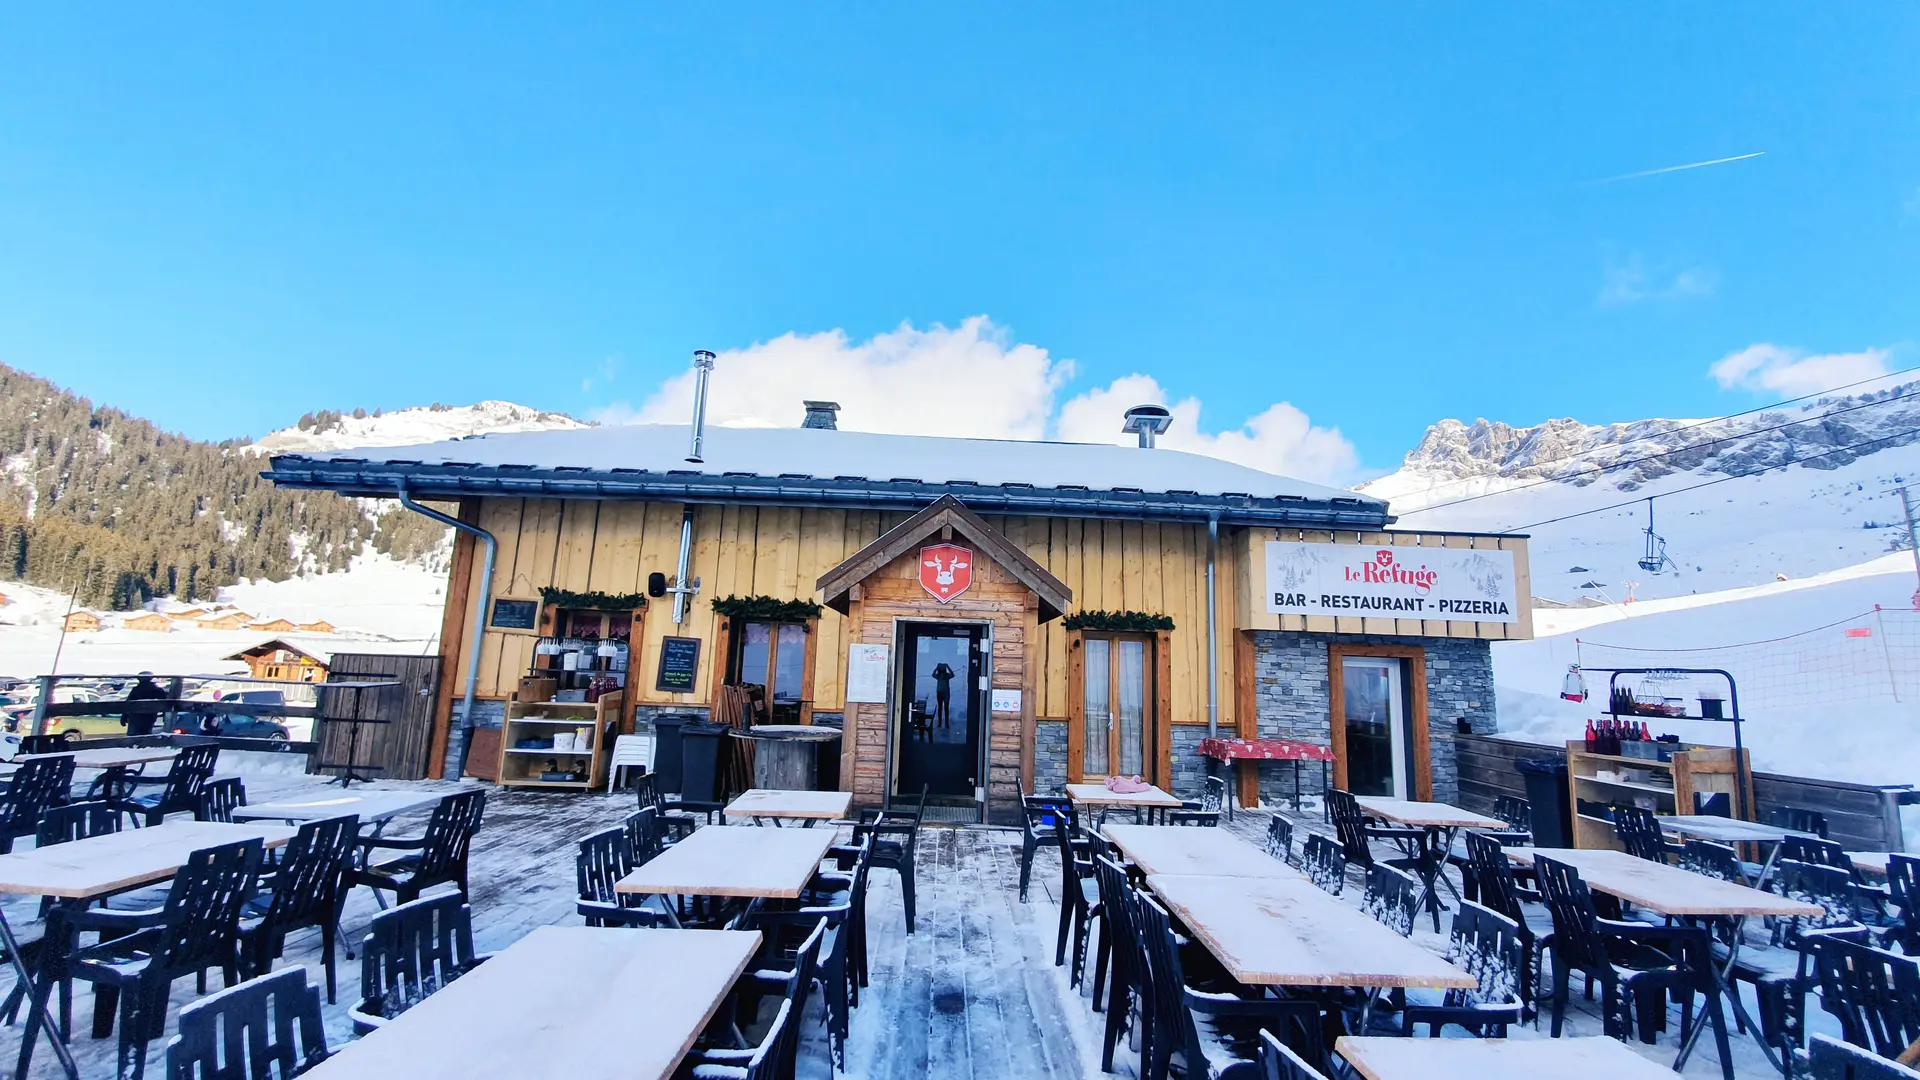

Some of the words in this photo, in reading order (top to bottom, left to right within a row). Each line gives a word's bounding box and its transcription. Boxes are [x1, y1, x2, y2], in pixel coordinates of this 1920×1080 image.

[1345, 566, 1361, 581] Le
[1360, 561, 1438, 596] Refuge
[1274, 592, 1307, 607] BAR
[1321, 594, 1425, 612] RESTAURANT
[1439, 599, 1510, 615] PIZZERIA
